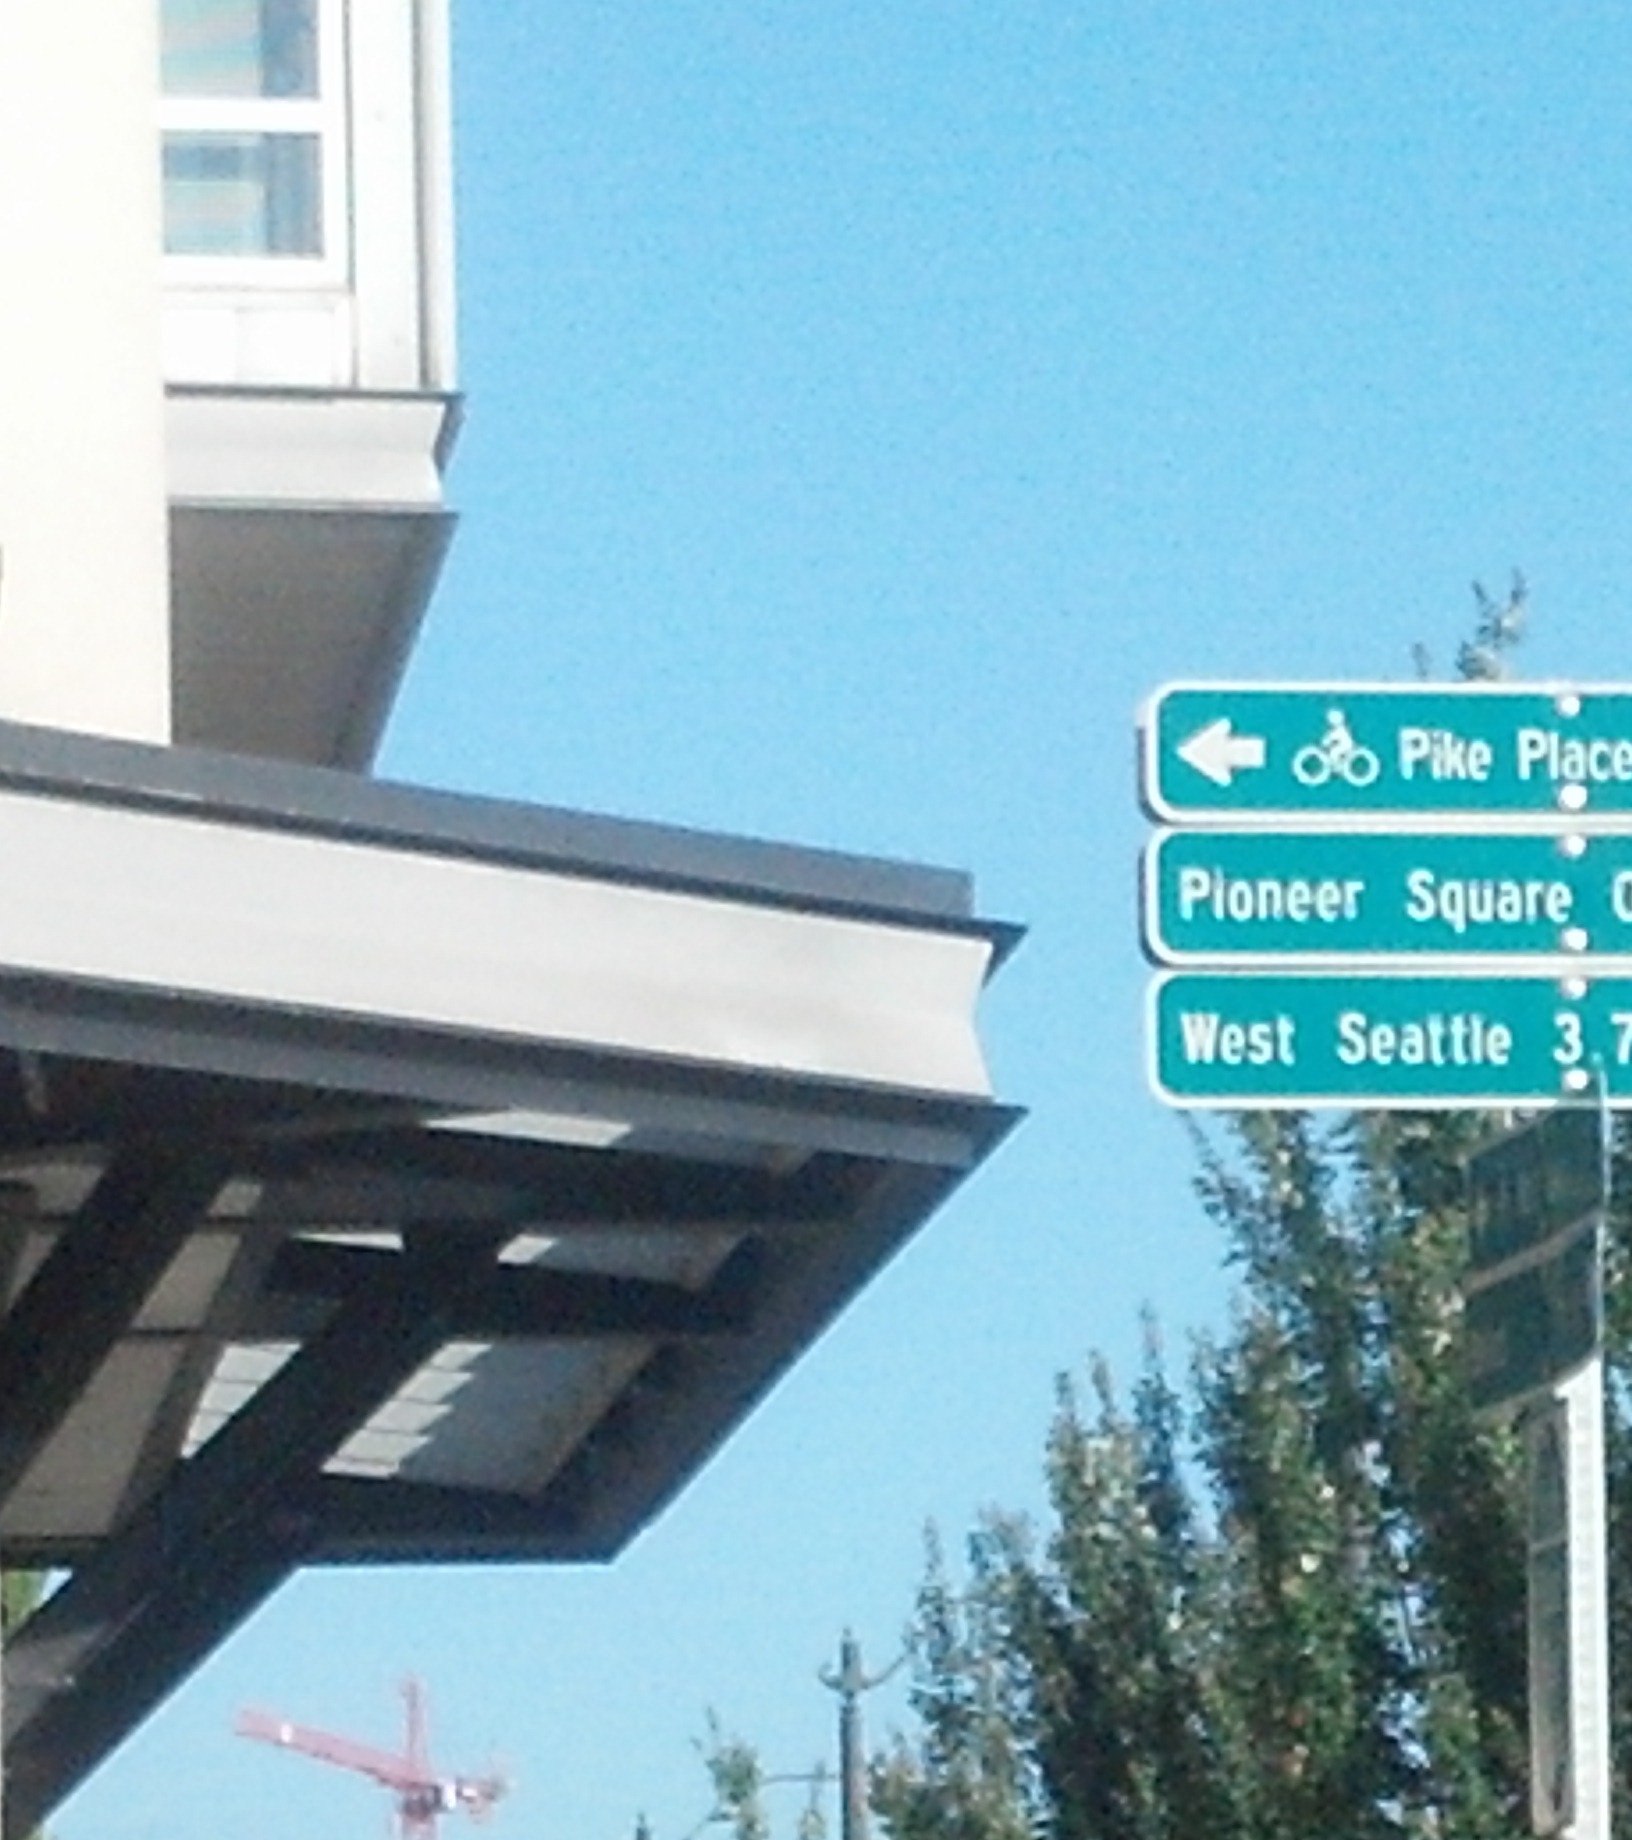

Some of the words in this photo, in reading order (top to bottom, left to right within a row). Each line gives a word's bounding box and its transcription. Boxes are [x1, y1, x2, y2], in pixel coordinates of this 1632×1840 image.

[1400, 727, 1491, 780] Pike
[1179, 867, 1364, 921] Pioneer
[1407, 869, 1572, 933] Square
[1180, 1012, 1294, 1064] West
[1338, 1011, 1512, 1065] Seattle
